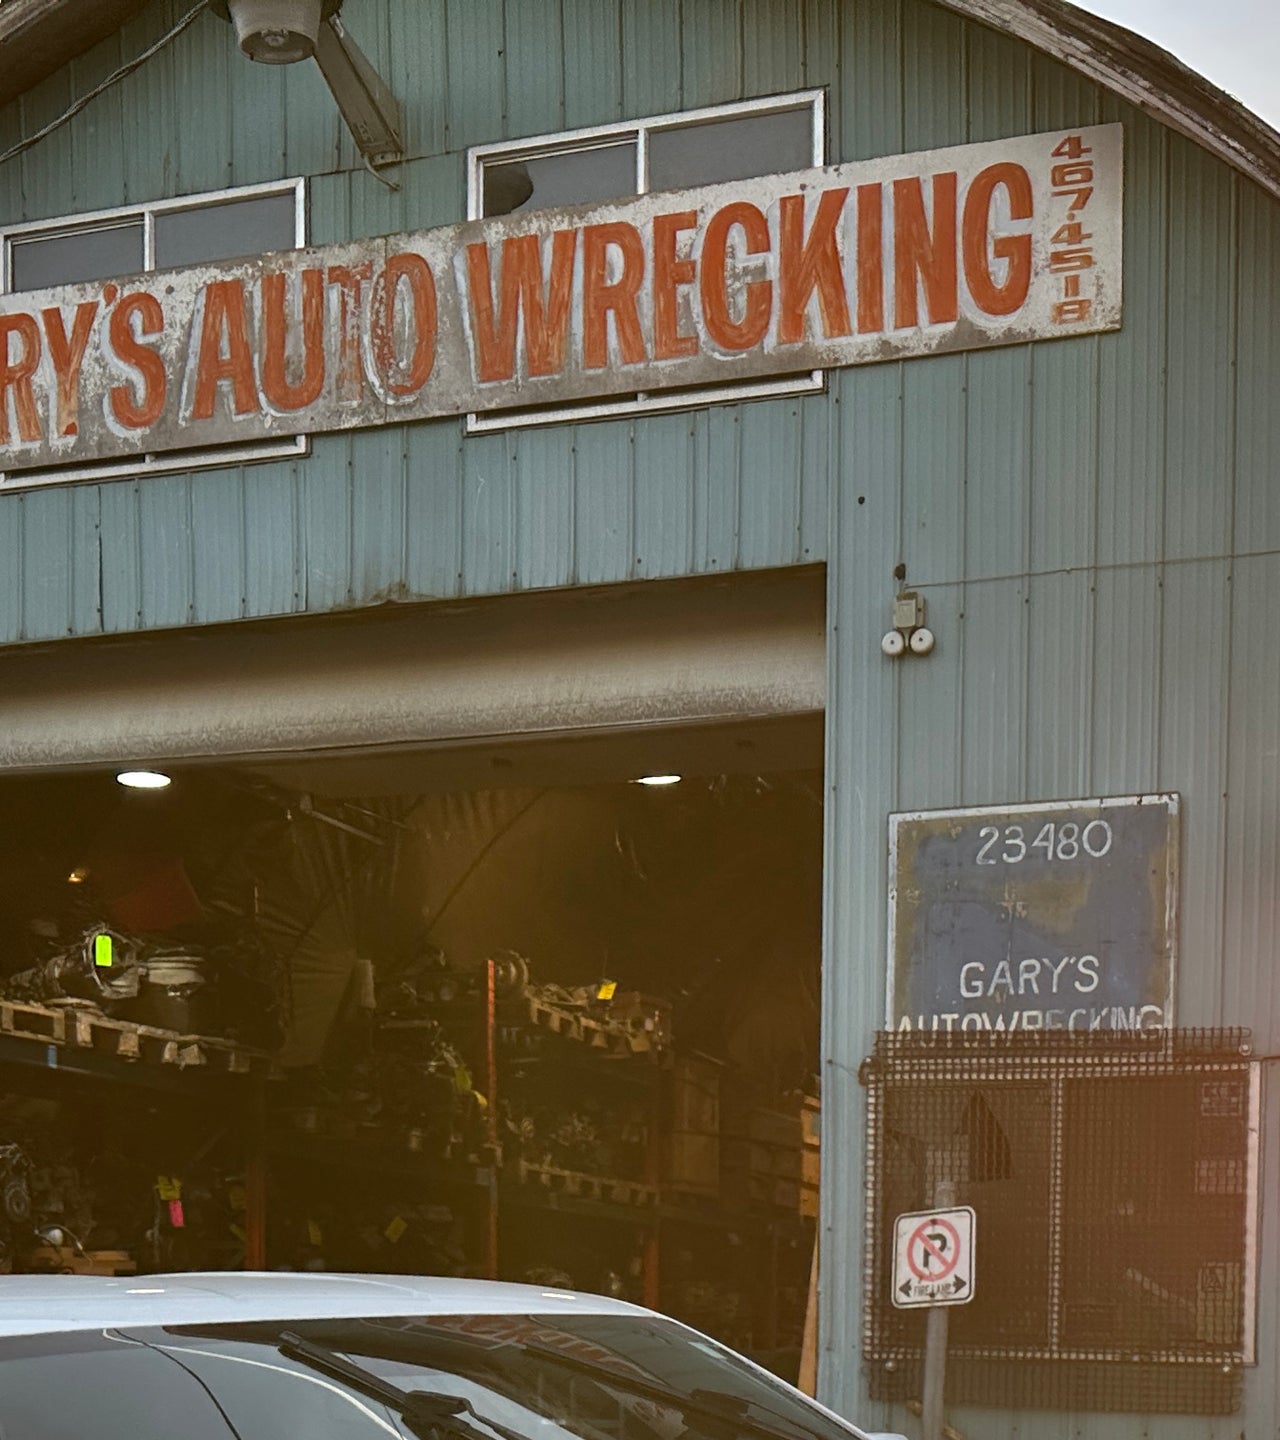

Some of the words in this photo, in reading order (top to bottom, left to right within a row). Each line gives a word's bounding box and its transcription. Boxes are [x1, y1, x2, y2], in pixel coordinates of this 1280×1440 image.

[190, 252, 437, 420] AUTO
[467, 161, 1034, 383] WRECKING
[975, 819, 1113, 866] 23480
[959, 954, 1100, 999] GARY'S
